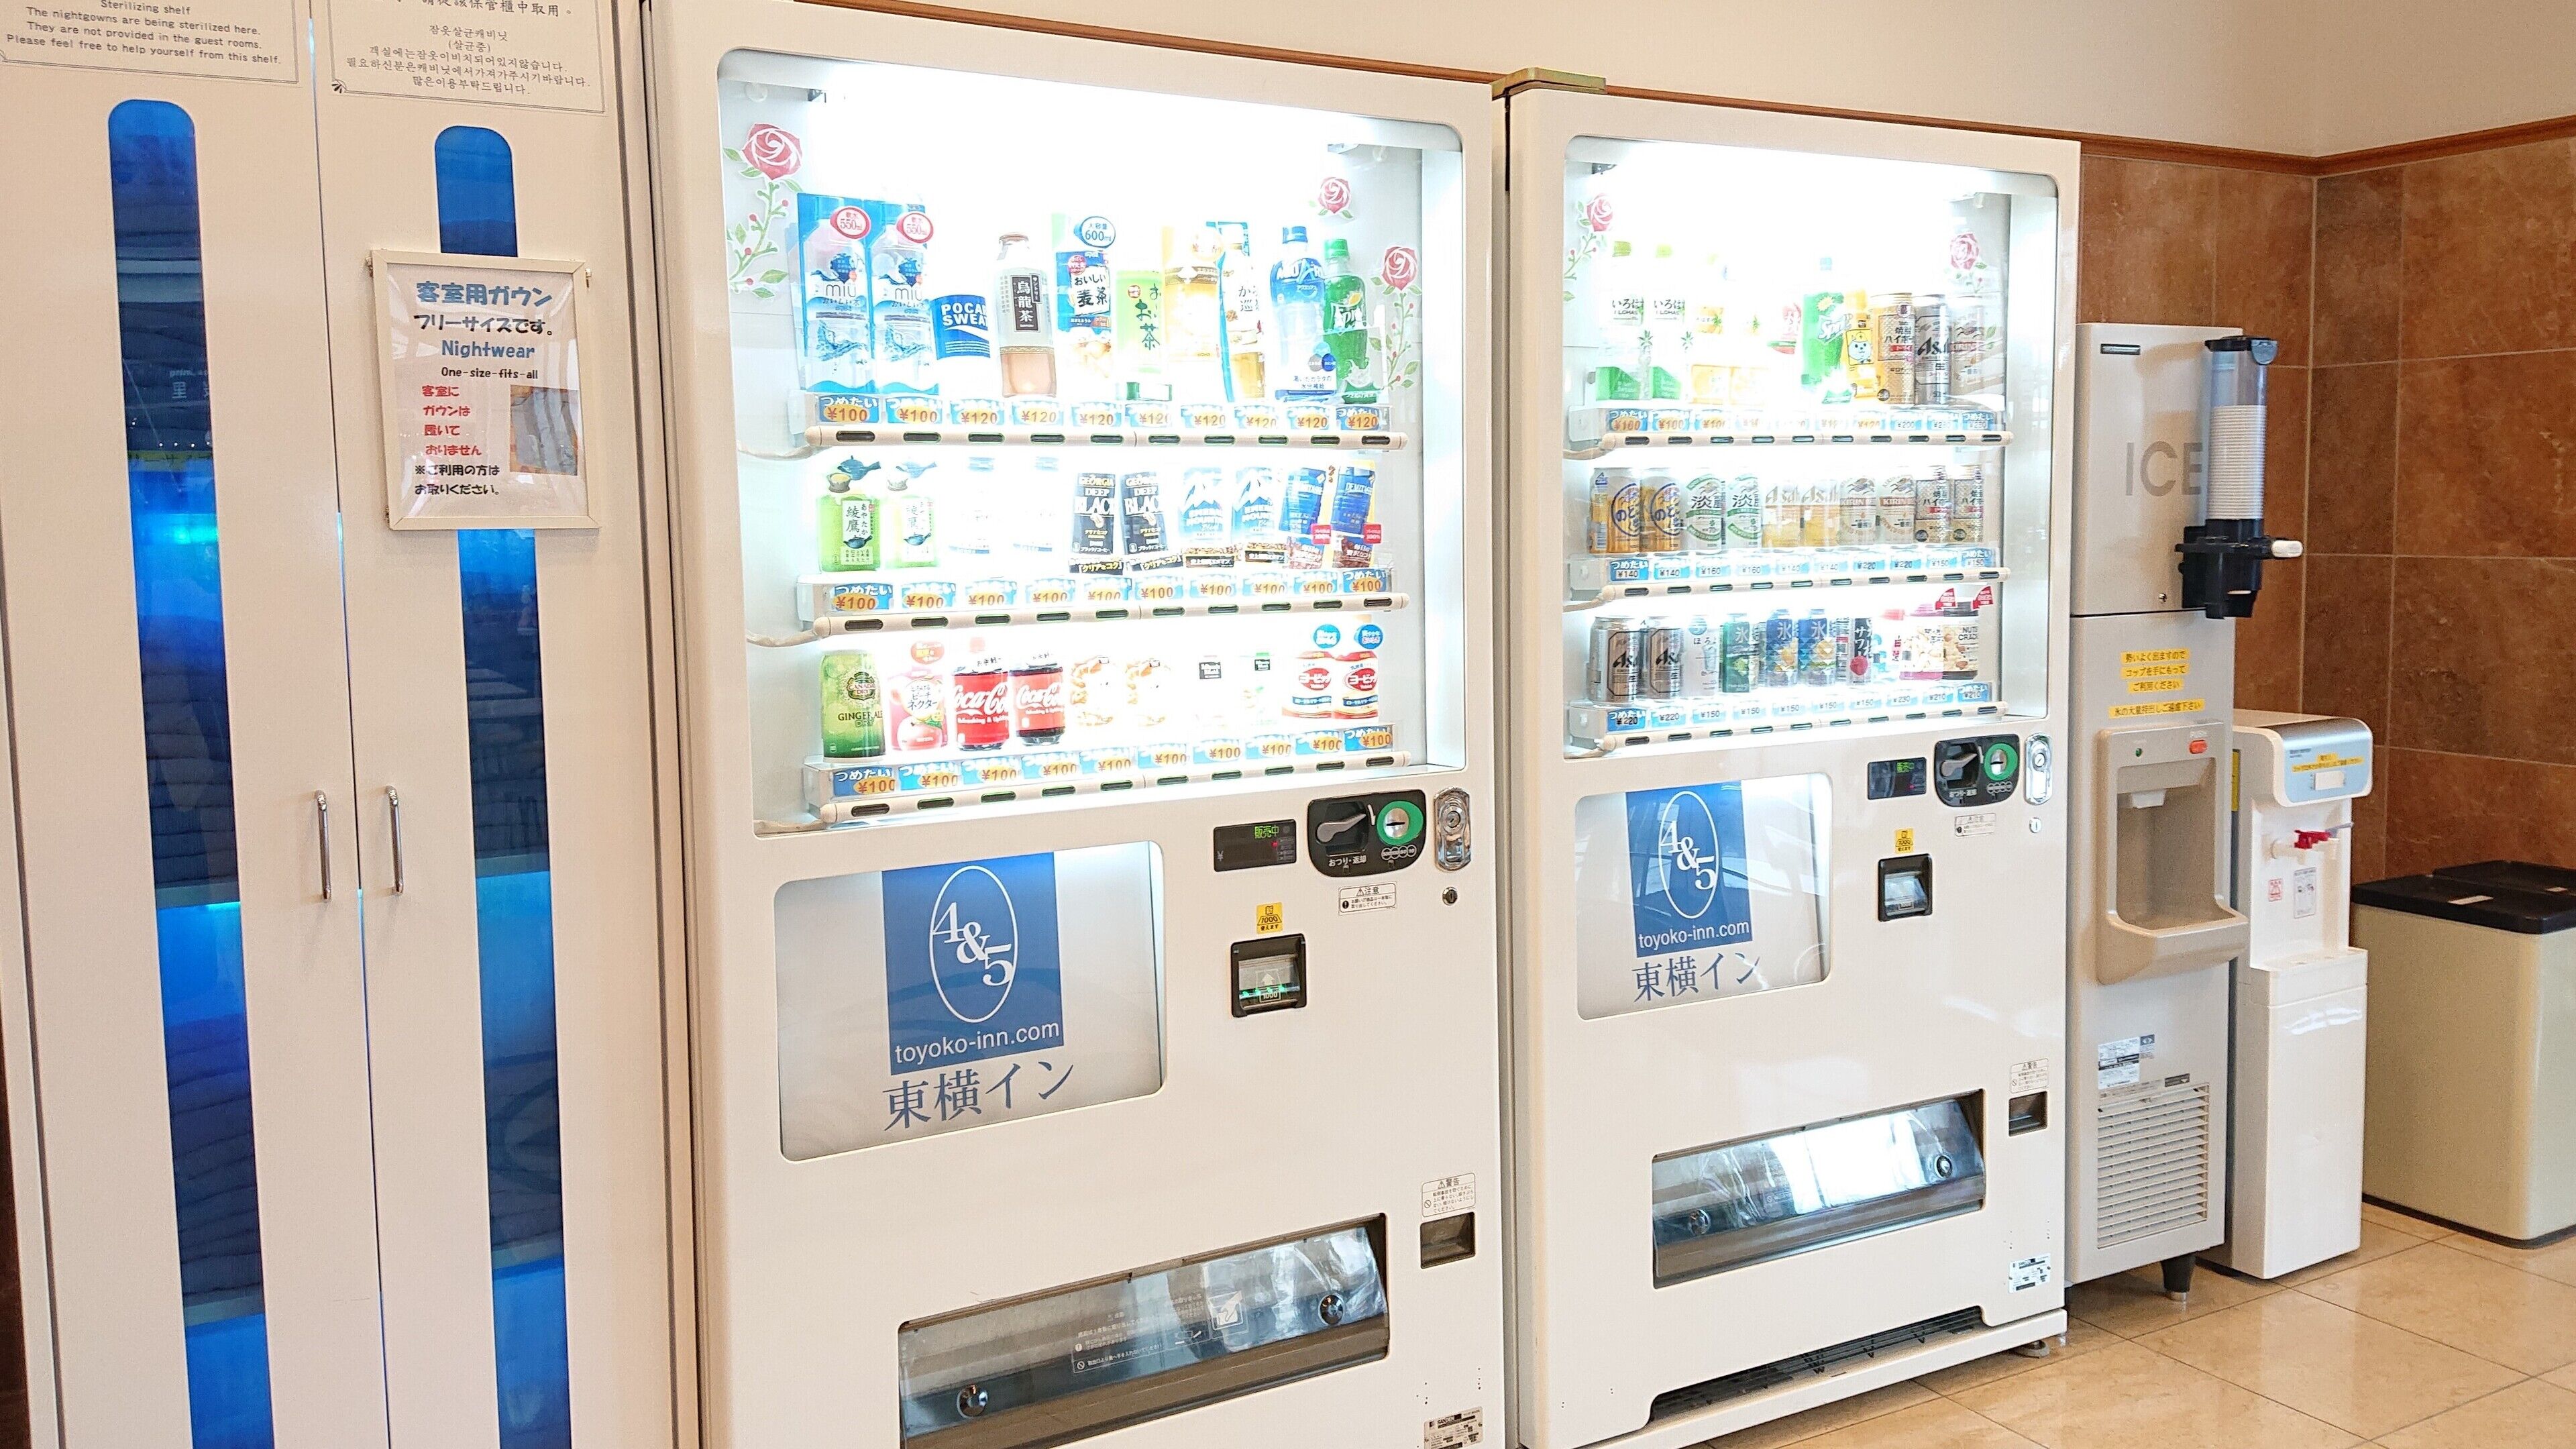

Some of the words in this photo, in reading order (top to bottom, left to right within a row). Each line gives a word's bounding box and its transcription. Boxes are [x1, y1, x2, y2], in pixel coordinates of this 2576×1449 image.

[101, 0, 159, 13] Sterilizing
[164, 6, 191, 14] shelf
[26, 7, 48, 16] The
[53, 10, 117, 23] nightgowns
[145, 17, 174, 28] being
[180, 21, 230, 32] sterilized
[235, 25, 260, 35] here.
[27, 21, 54, 33] They
[106, 30, 154, 40] provided
[159, 33, 168, 41] in
[174, 34, 190, 43] the
[195, 37, 223, 46] guest
[228, 41, 262, 49] rooms.
[7, 34, 46, 46] Please
[51, 38, 73, 48] feel
[79, 40, 101, 50] free
[107, 43, 117, 51] to
[122, 44, 146, 54] help
[151, 47, 194, 57] yourself
[199, 50, 223, 60] from
[229, 52, 248, 62] this
[252, 55, 281, 64] shelf.
[1074, 274, 1107, 286] おいしい
[416, 280, 552, 307] 客室用ガウン
[1077, 286, 1108, 308] 麦茶
[413, 313, 553, 336] フリーサイズです。
[441, 340, 535, 358] Nightwear
[441, 367, 538, 380] One-size-fits-all
[422, 386, 460, 397] 客室に
[820, 396, 879, 409] つめたい
[423, 405, 470, 417] ガウンは
[827, 407, 868, 422] ¥100
[900, 408, 938, 423] ¥100
[961, 411, 998, 424] ¥120
[1021, 411, 1057, 423] ¥120
[1079, 413, 1114, 425] ¥120
[1194, 414, 1226, 427] ¥120
[1246, 415, 1277, 428] ¥120
[1297, 416, 1328, 429] ¥120
[1348, 415, 1378, 429] ¥120
[425, 445, 482, 456] おりません
[2125, 441, 2204, 496] ICE
[415, 484, 500, 496] お取りください。
[846, 505, 861, 533] 綾鷹
[1617, 571, 1638, 579] ¥140
[836, 586, 892, 597] つめたい
[1200, 584, 1232, 596] ¥100
[1254, 584, 1285, 596] ¥100
[1303, 582, 1334, 594] ¥100
[1352, 580, 1382, 592] ¥100
[1032, 592, 1068, 603] ¥100
[1087, 590, 1121, 602] ¥100
[1141, 586, 1173, 600] ¥100
[836, 596, 876, 610] ¥100
[906, 596, 944, 608] ¥100
[968, 594, 1005, 606] ¥100
[2126, 665, 2186, 678] コップを手にもって
[912, 692, 931, 700] ピーチ
[907, 699, 938, 711] ネクター
[1616, 717, 1638, 726] ¥220
[1660, 713, 1680, 721] ¥220
[1312, 739, 1342, 751] ¥100
[1362, 734, 1392, 747] ¥100
[1208, 747, 1241, 759] ¥100
[1262, 743, 1291, 756] ¥100
[1098, 759, 1132, 773] ¥100
[1155, 753, 1187, 766] ¥100
[835, 768, 892, 782] つめたい
[981, 769, 1017, 782] ¥100
[1042, 763, 1077, 777] ¥100
[857, 779, 896, 794] ¥100
[921, 774, 959, 788] ¥100
[1254, 825, 1280, 839] 販売中
[1660, 820, 1715, 890] 4&5
[1261, 916, 1279, 924] 1000
[1638, 920, 1750, 951] toyoko-inn.com
[932, 902, 1015, 987] 4&5
[1631, 953, 1760, 1002] 東横イン
[895, 1022, 1060, 1065] toyoko-inn.com
[882, 1061, 1074, 1132] 東横イン
